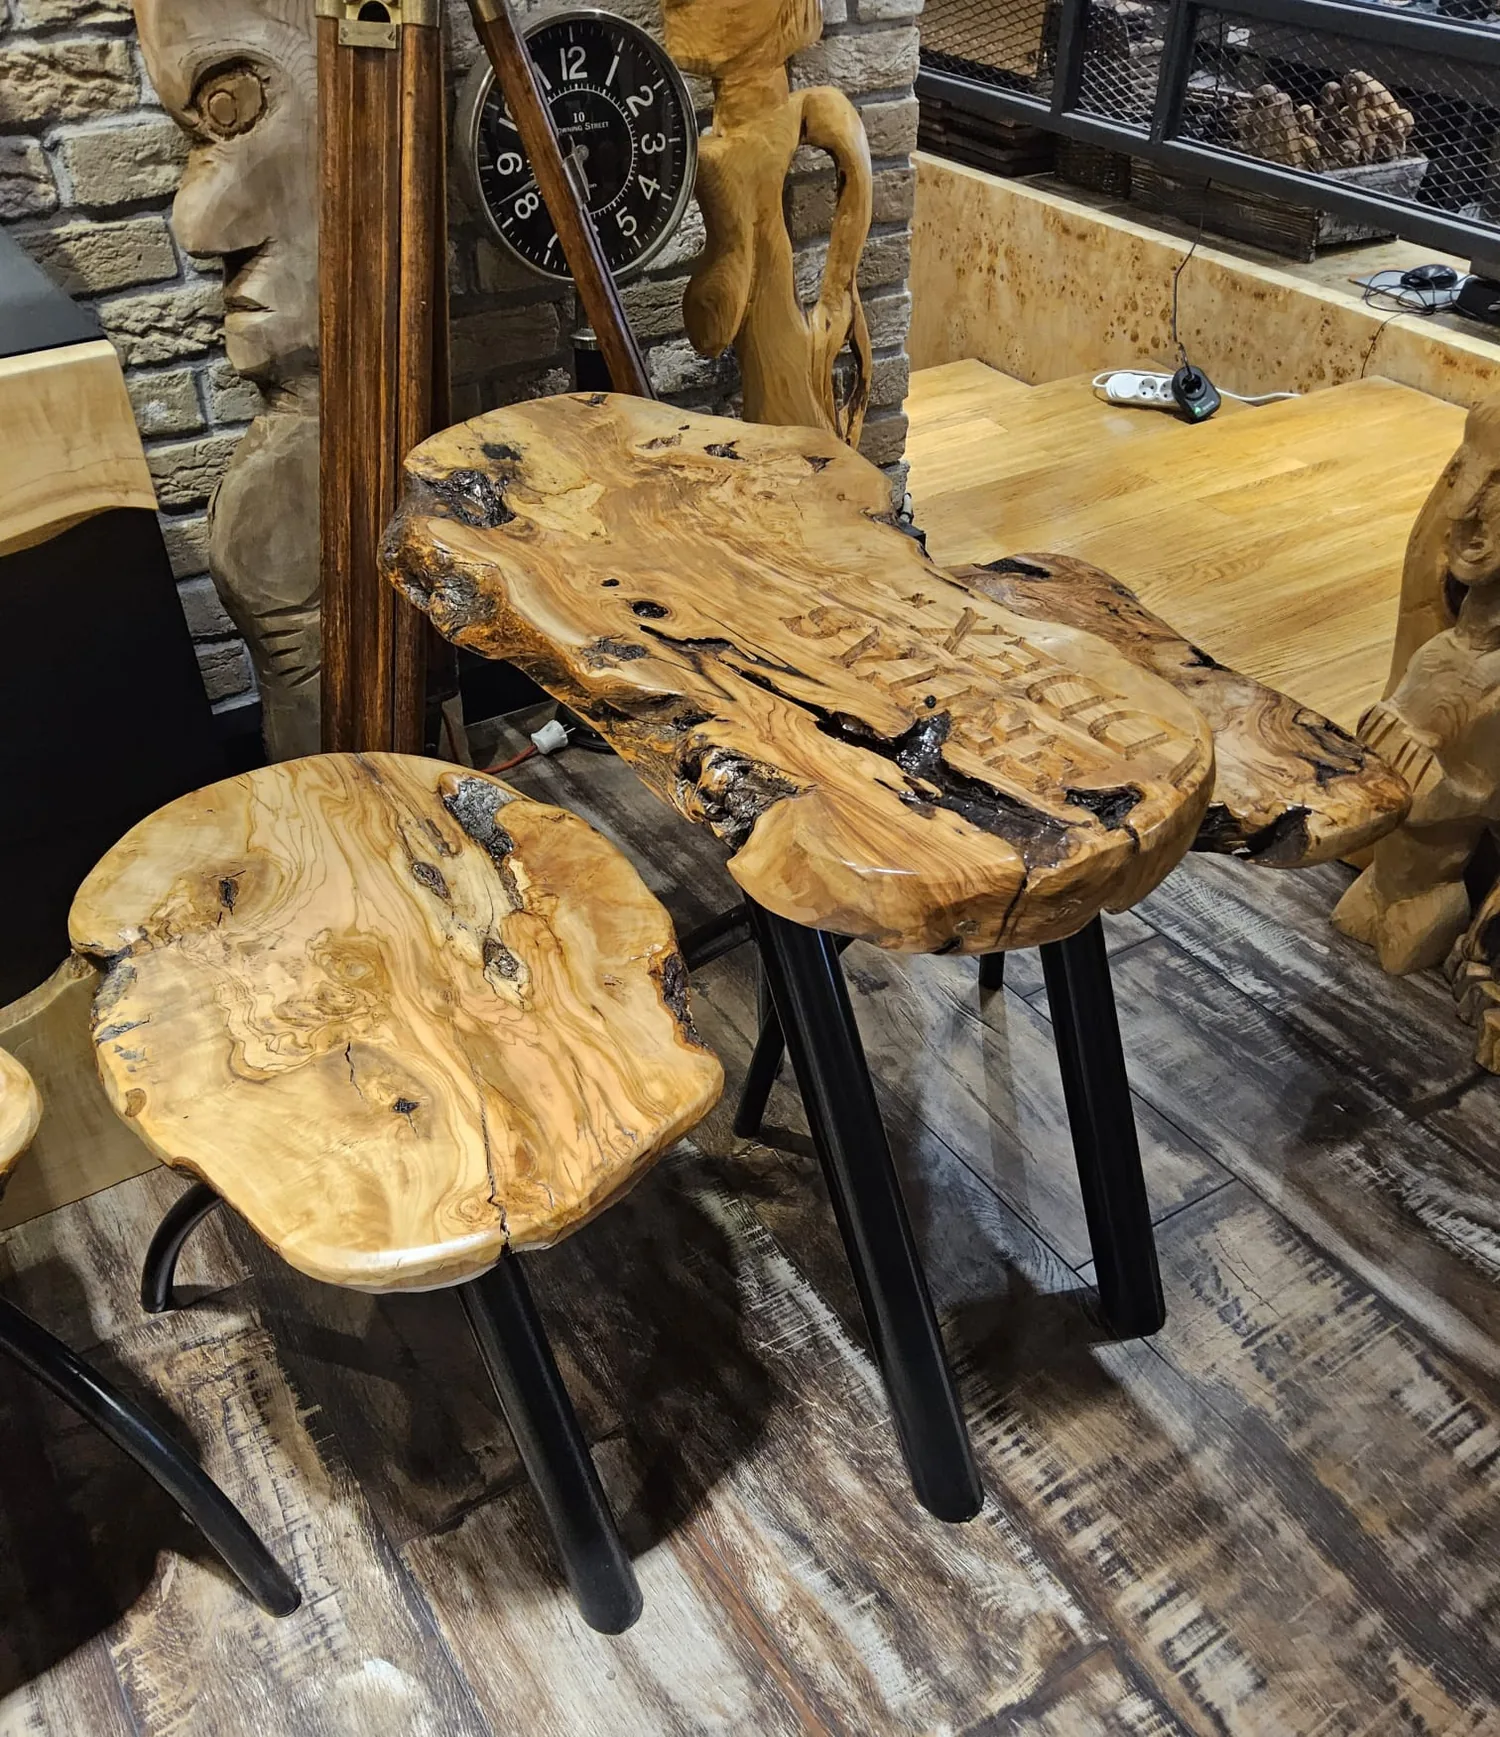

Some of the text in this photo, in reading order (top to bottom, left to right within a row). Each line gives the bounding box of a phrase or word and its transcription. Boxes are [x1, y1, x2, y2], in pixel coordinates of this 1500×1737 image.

[560, 46, 587, 81] 12
[605, 55, 620, 87] 1
[626, 85, 653, 118] 2
[557, 124, 582, 133] OWNING
[573, 111, 585, 123] 10
[641, 132, 666, 154] 3
[497, 152, 522, 175] 9
[638, 174, 660, 200] 4
[515, 192, 539, 219] 8
[616, 206, 637, 236] 5
